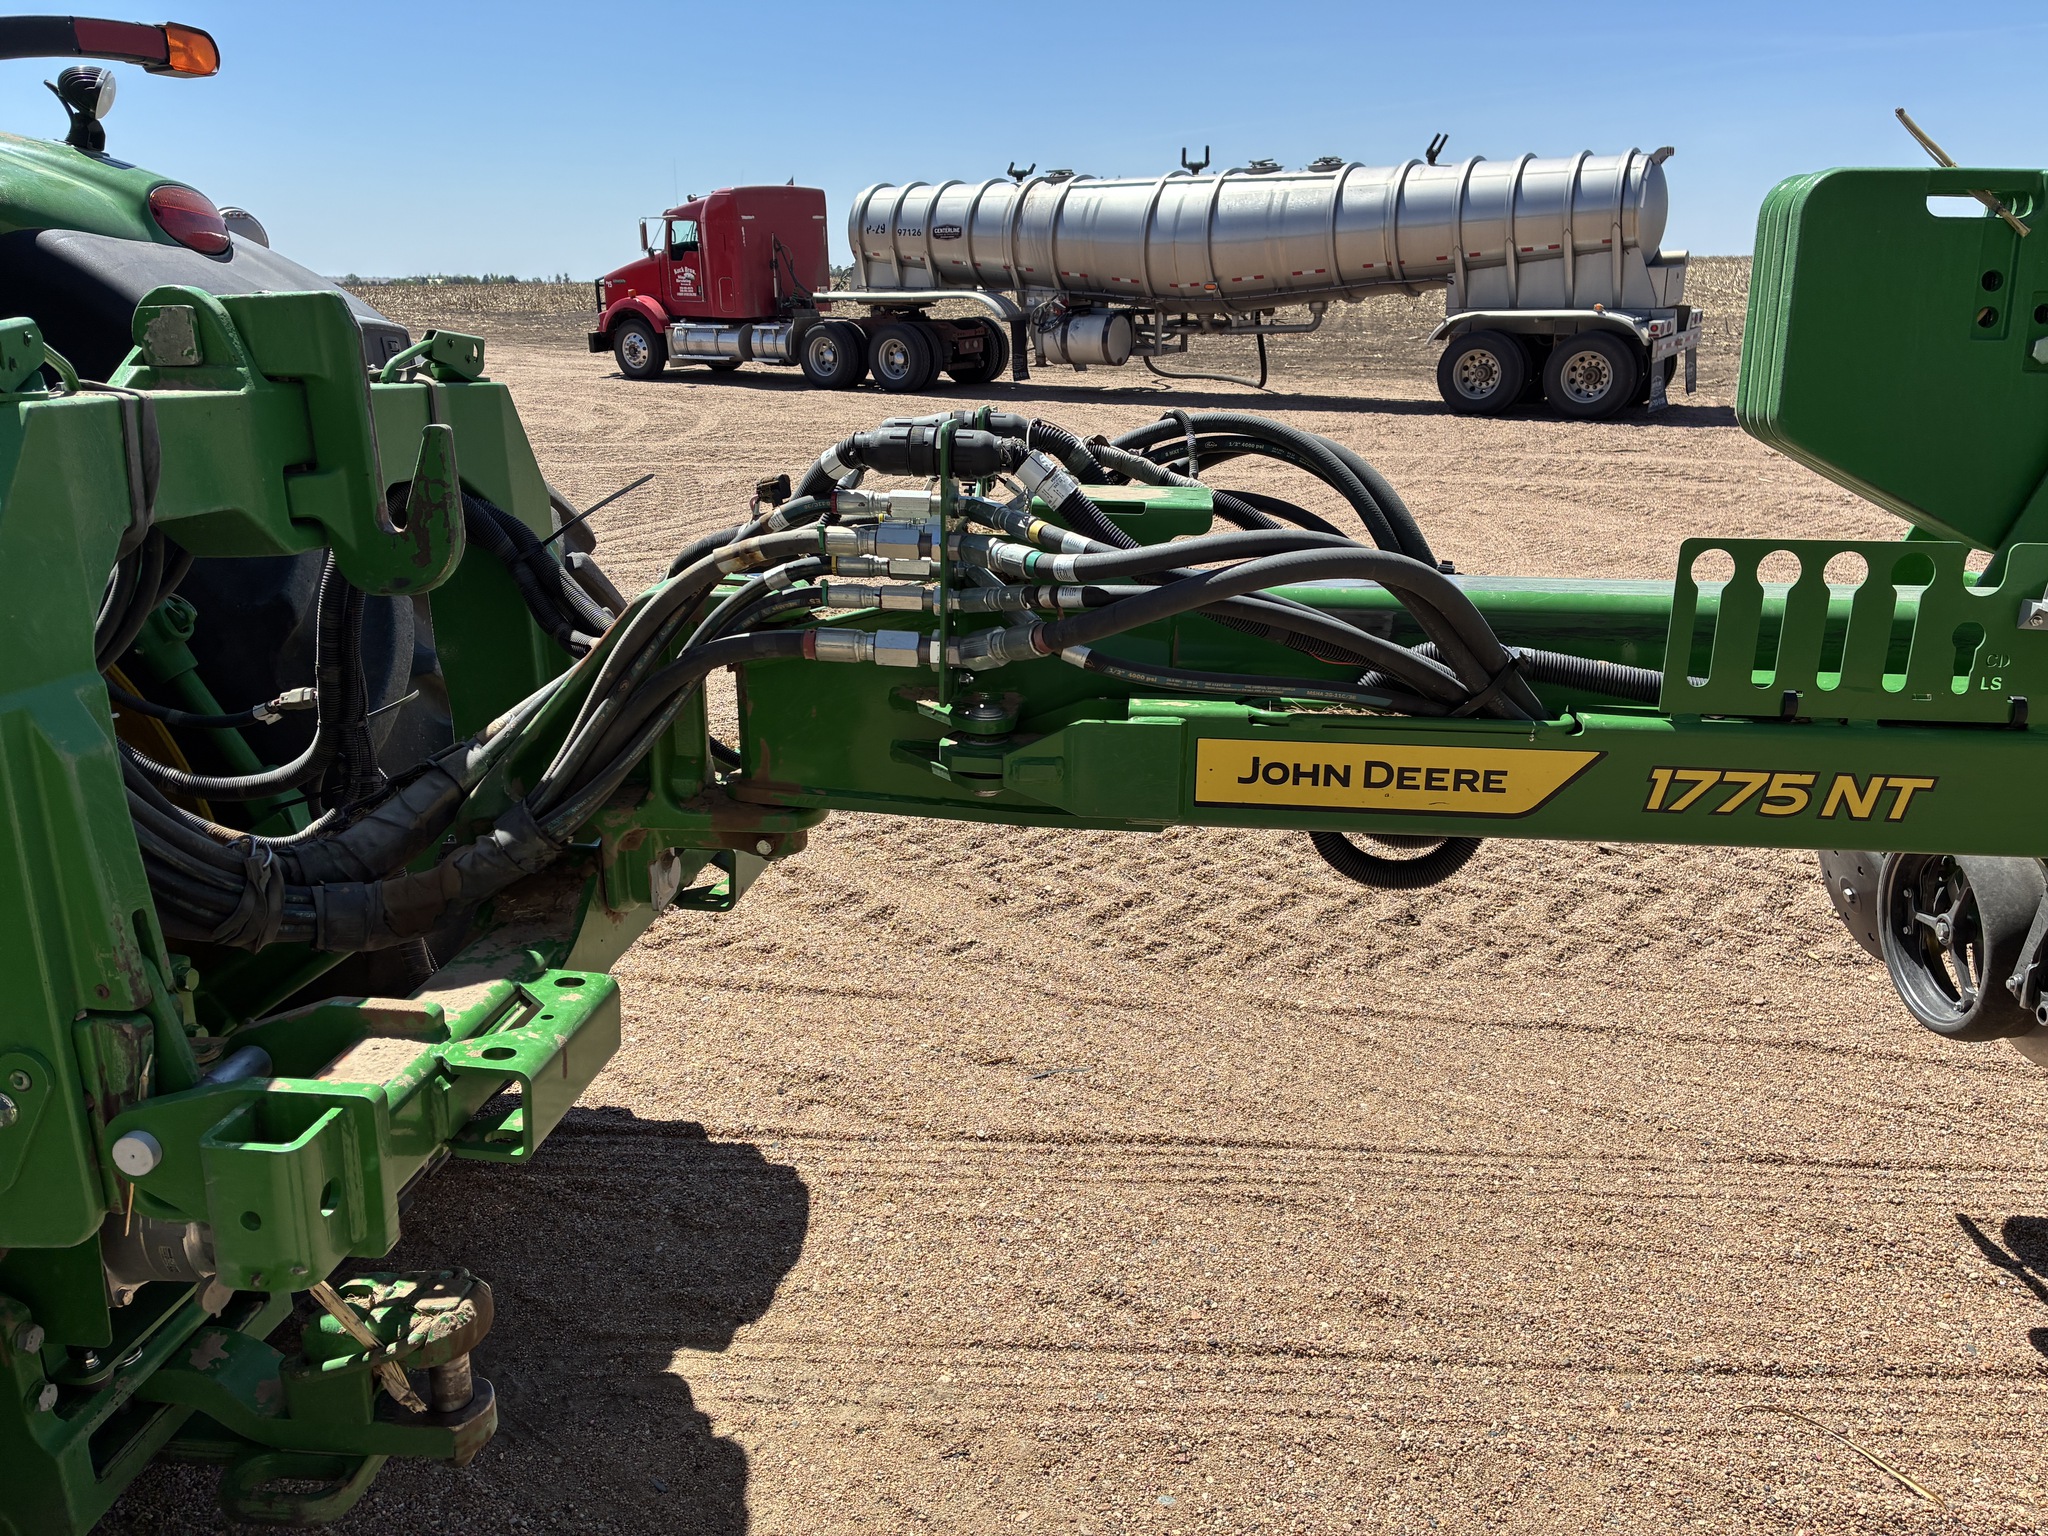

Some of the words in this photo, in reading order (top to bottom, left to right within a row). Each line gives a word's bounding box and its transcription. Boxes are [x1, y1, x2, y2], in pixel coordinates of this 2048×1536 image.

[1980, 676, 2002, 690] LS
[1237, 756, 1351, 788] JOHN
[1363, 760, 1508, 794] DEERE
[1642, 766, 1820, 818] 1775
[1816, 772, 1940, 823] NT
